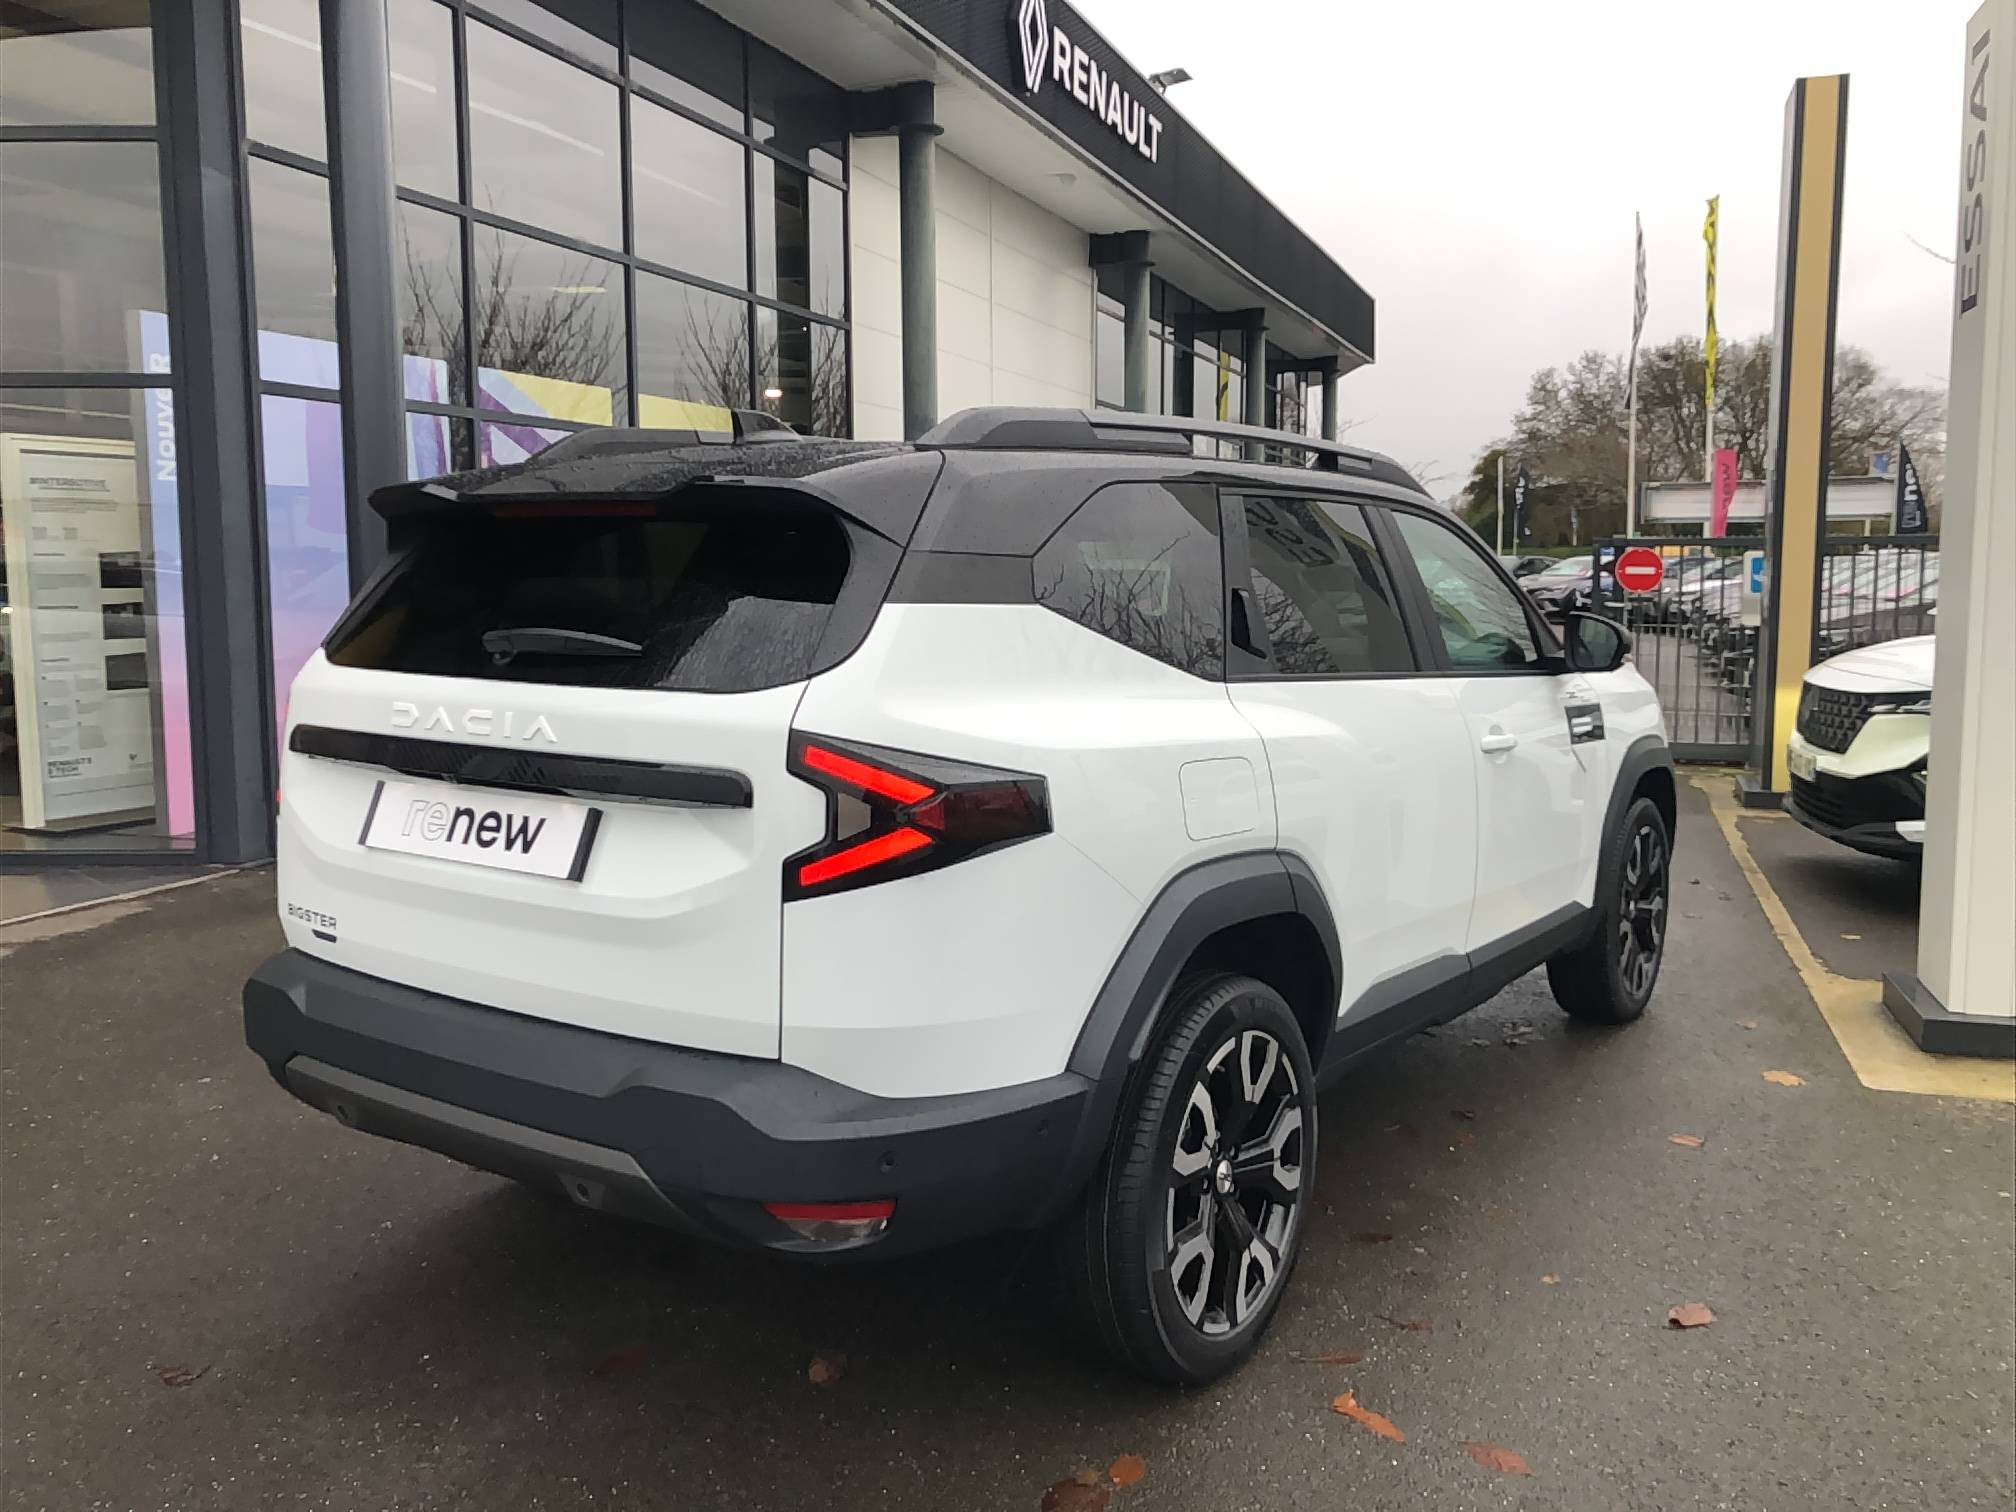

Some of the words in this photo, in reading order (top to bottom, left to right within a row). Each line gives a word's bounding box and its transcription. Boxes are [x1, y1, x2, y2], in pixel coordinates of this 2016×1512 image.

[1053, 25, 1163, 164] RENAULT
[1960, 28, 1991, 318] ESSAI
[390, 701, 558, 743] DACIA
[401, 799, 547, 855] renew
[287, 903, 337, 930] BIGSTER
